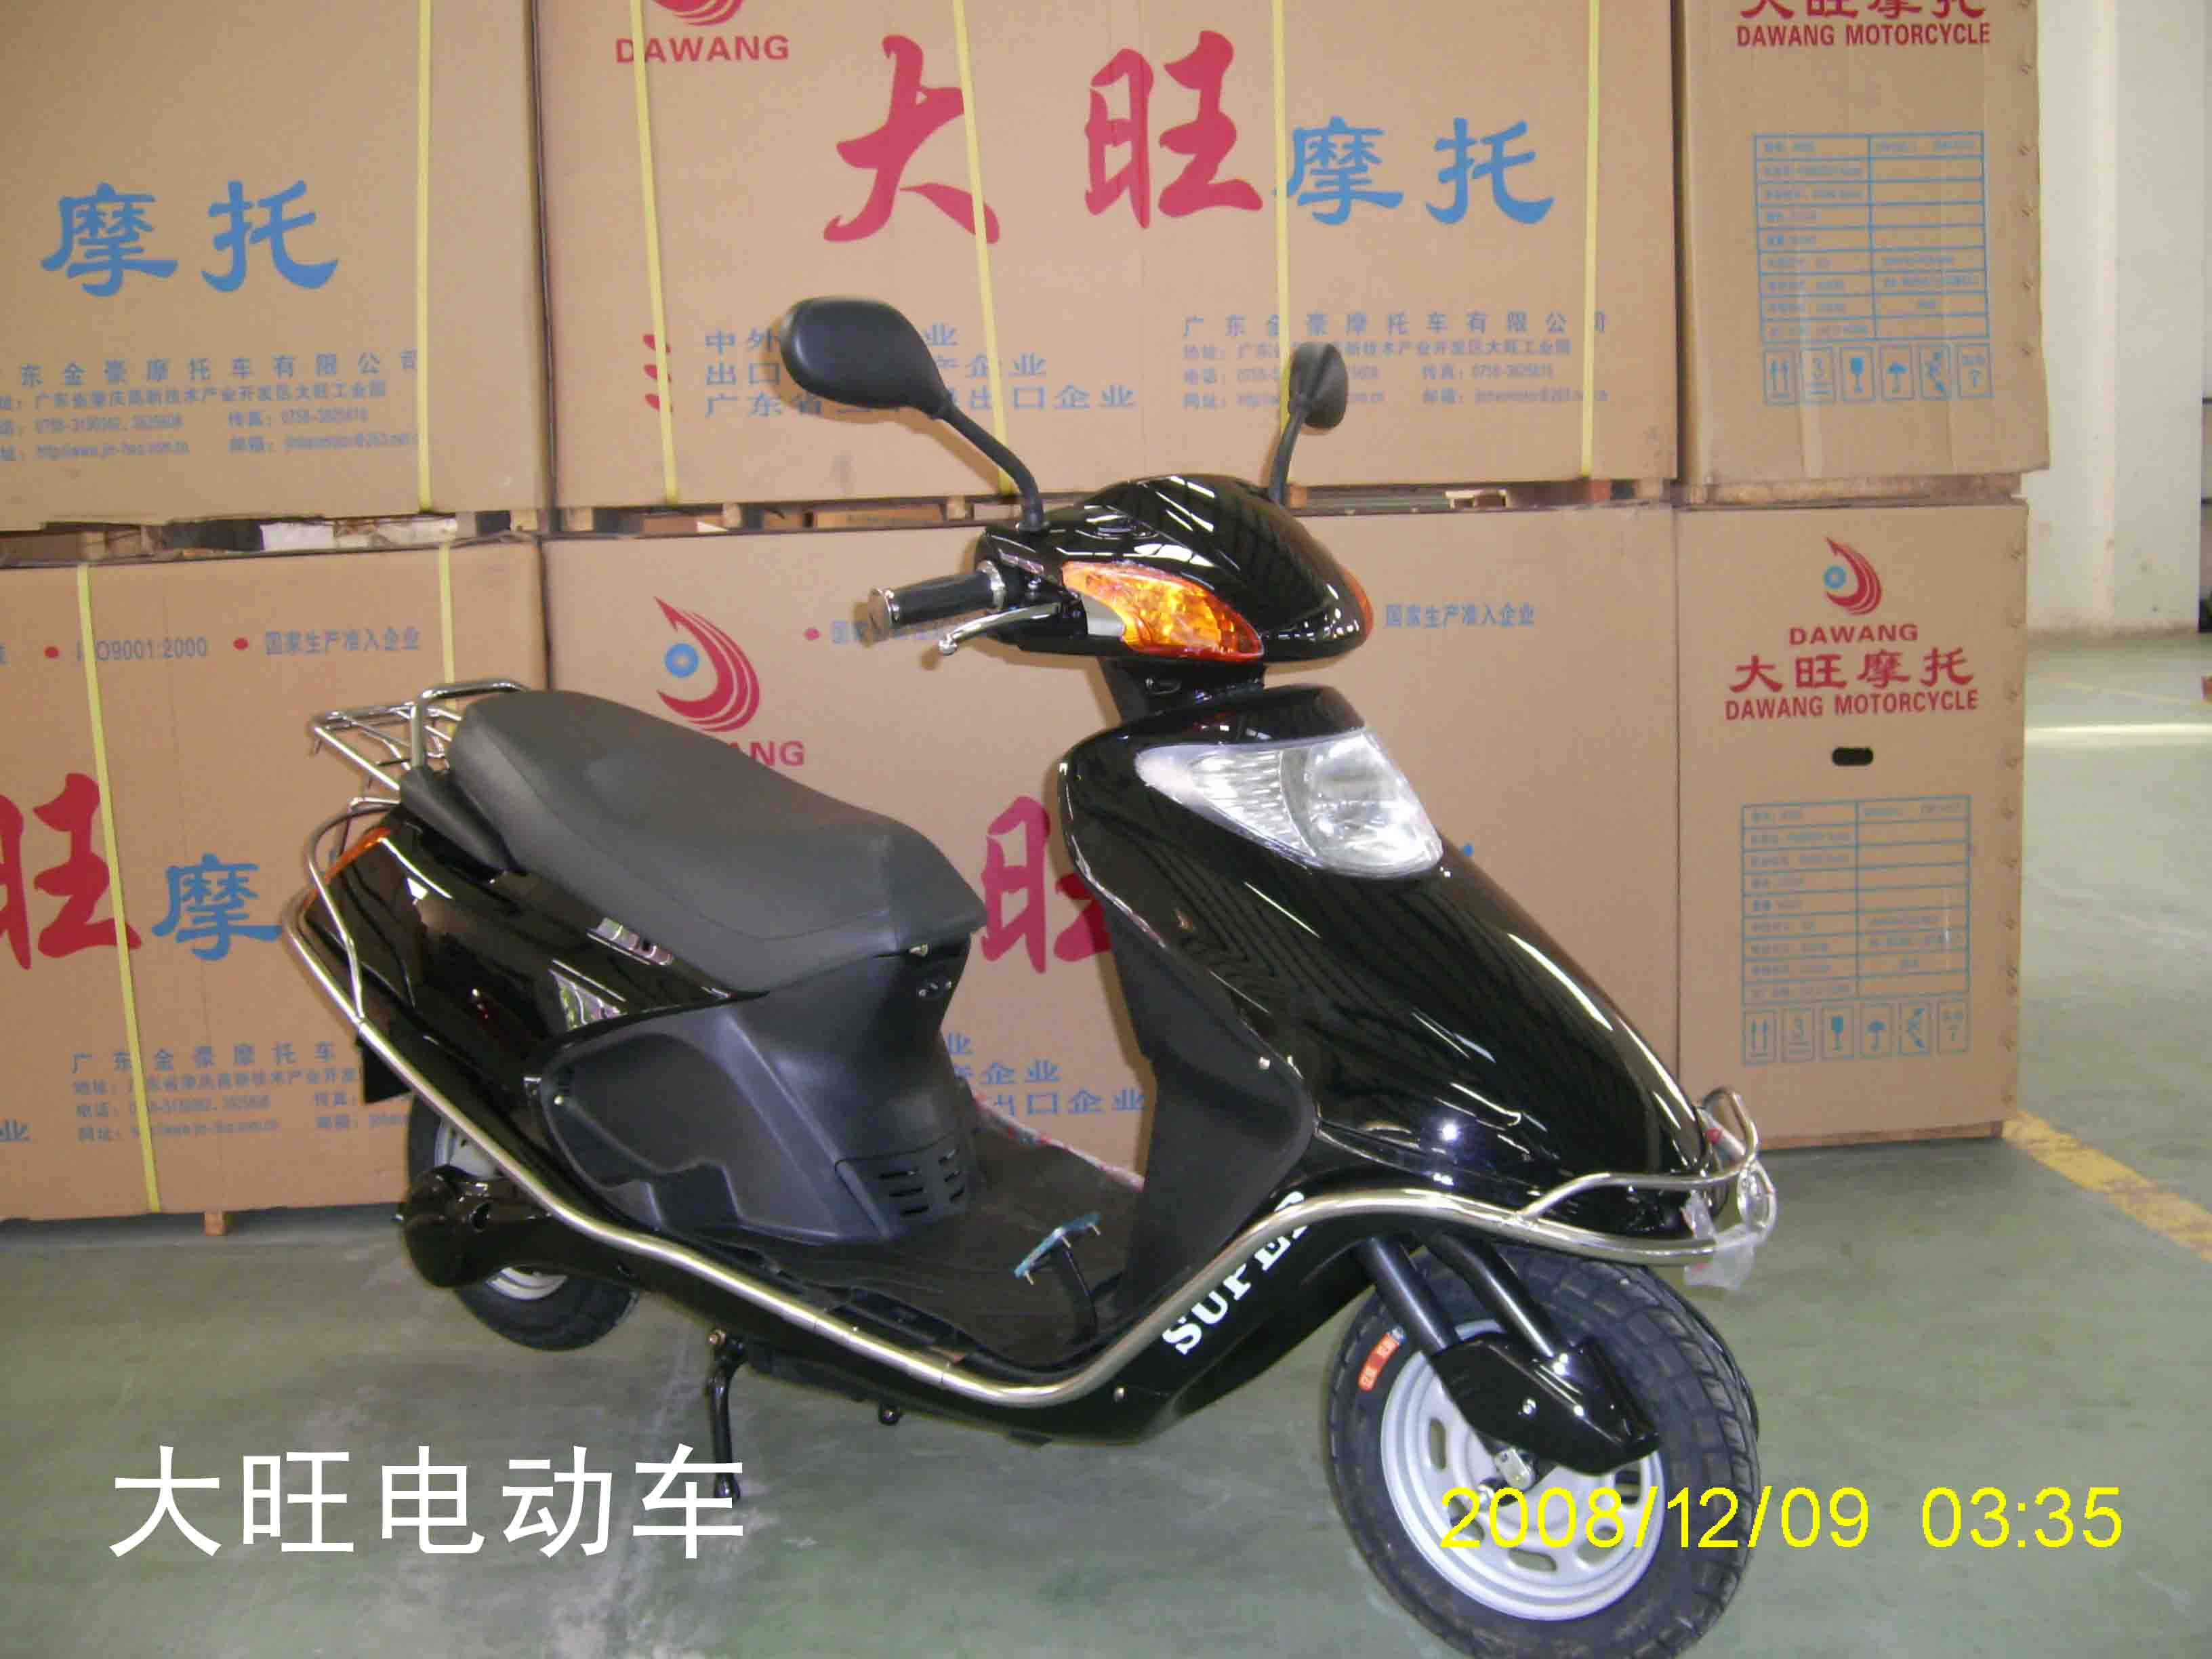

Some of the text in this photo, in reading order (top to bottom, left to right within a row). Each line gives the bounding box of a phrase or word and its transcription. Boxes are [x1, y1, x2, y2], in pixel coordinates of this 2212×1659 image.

[615, 34, 789, 63] DAWANG
[1737, 22, 1990, 47] DAWANG MOTORCYCLE
[41, 179, 339, 298] 摩托
[1789, 623, 1919, 646] DAWANG
[1729, 646, 1973, 693] 大旺摩托
[1725, 689, 1979, 720] DAWANG MOTORCYCLE
